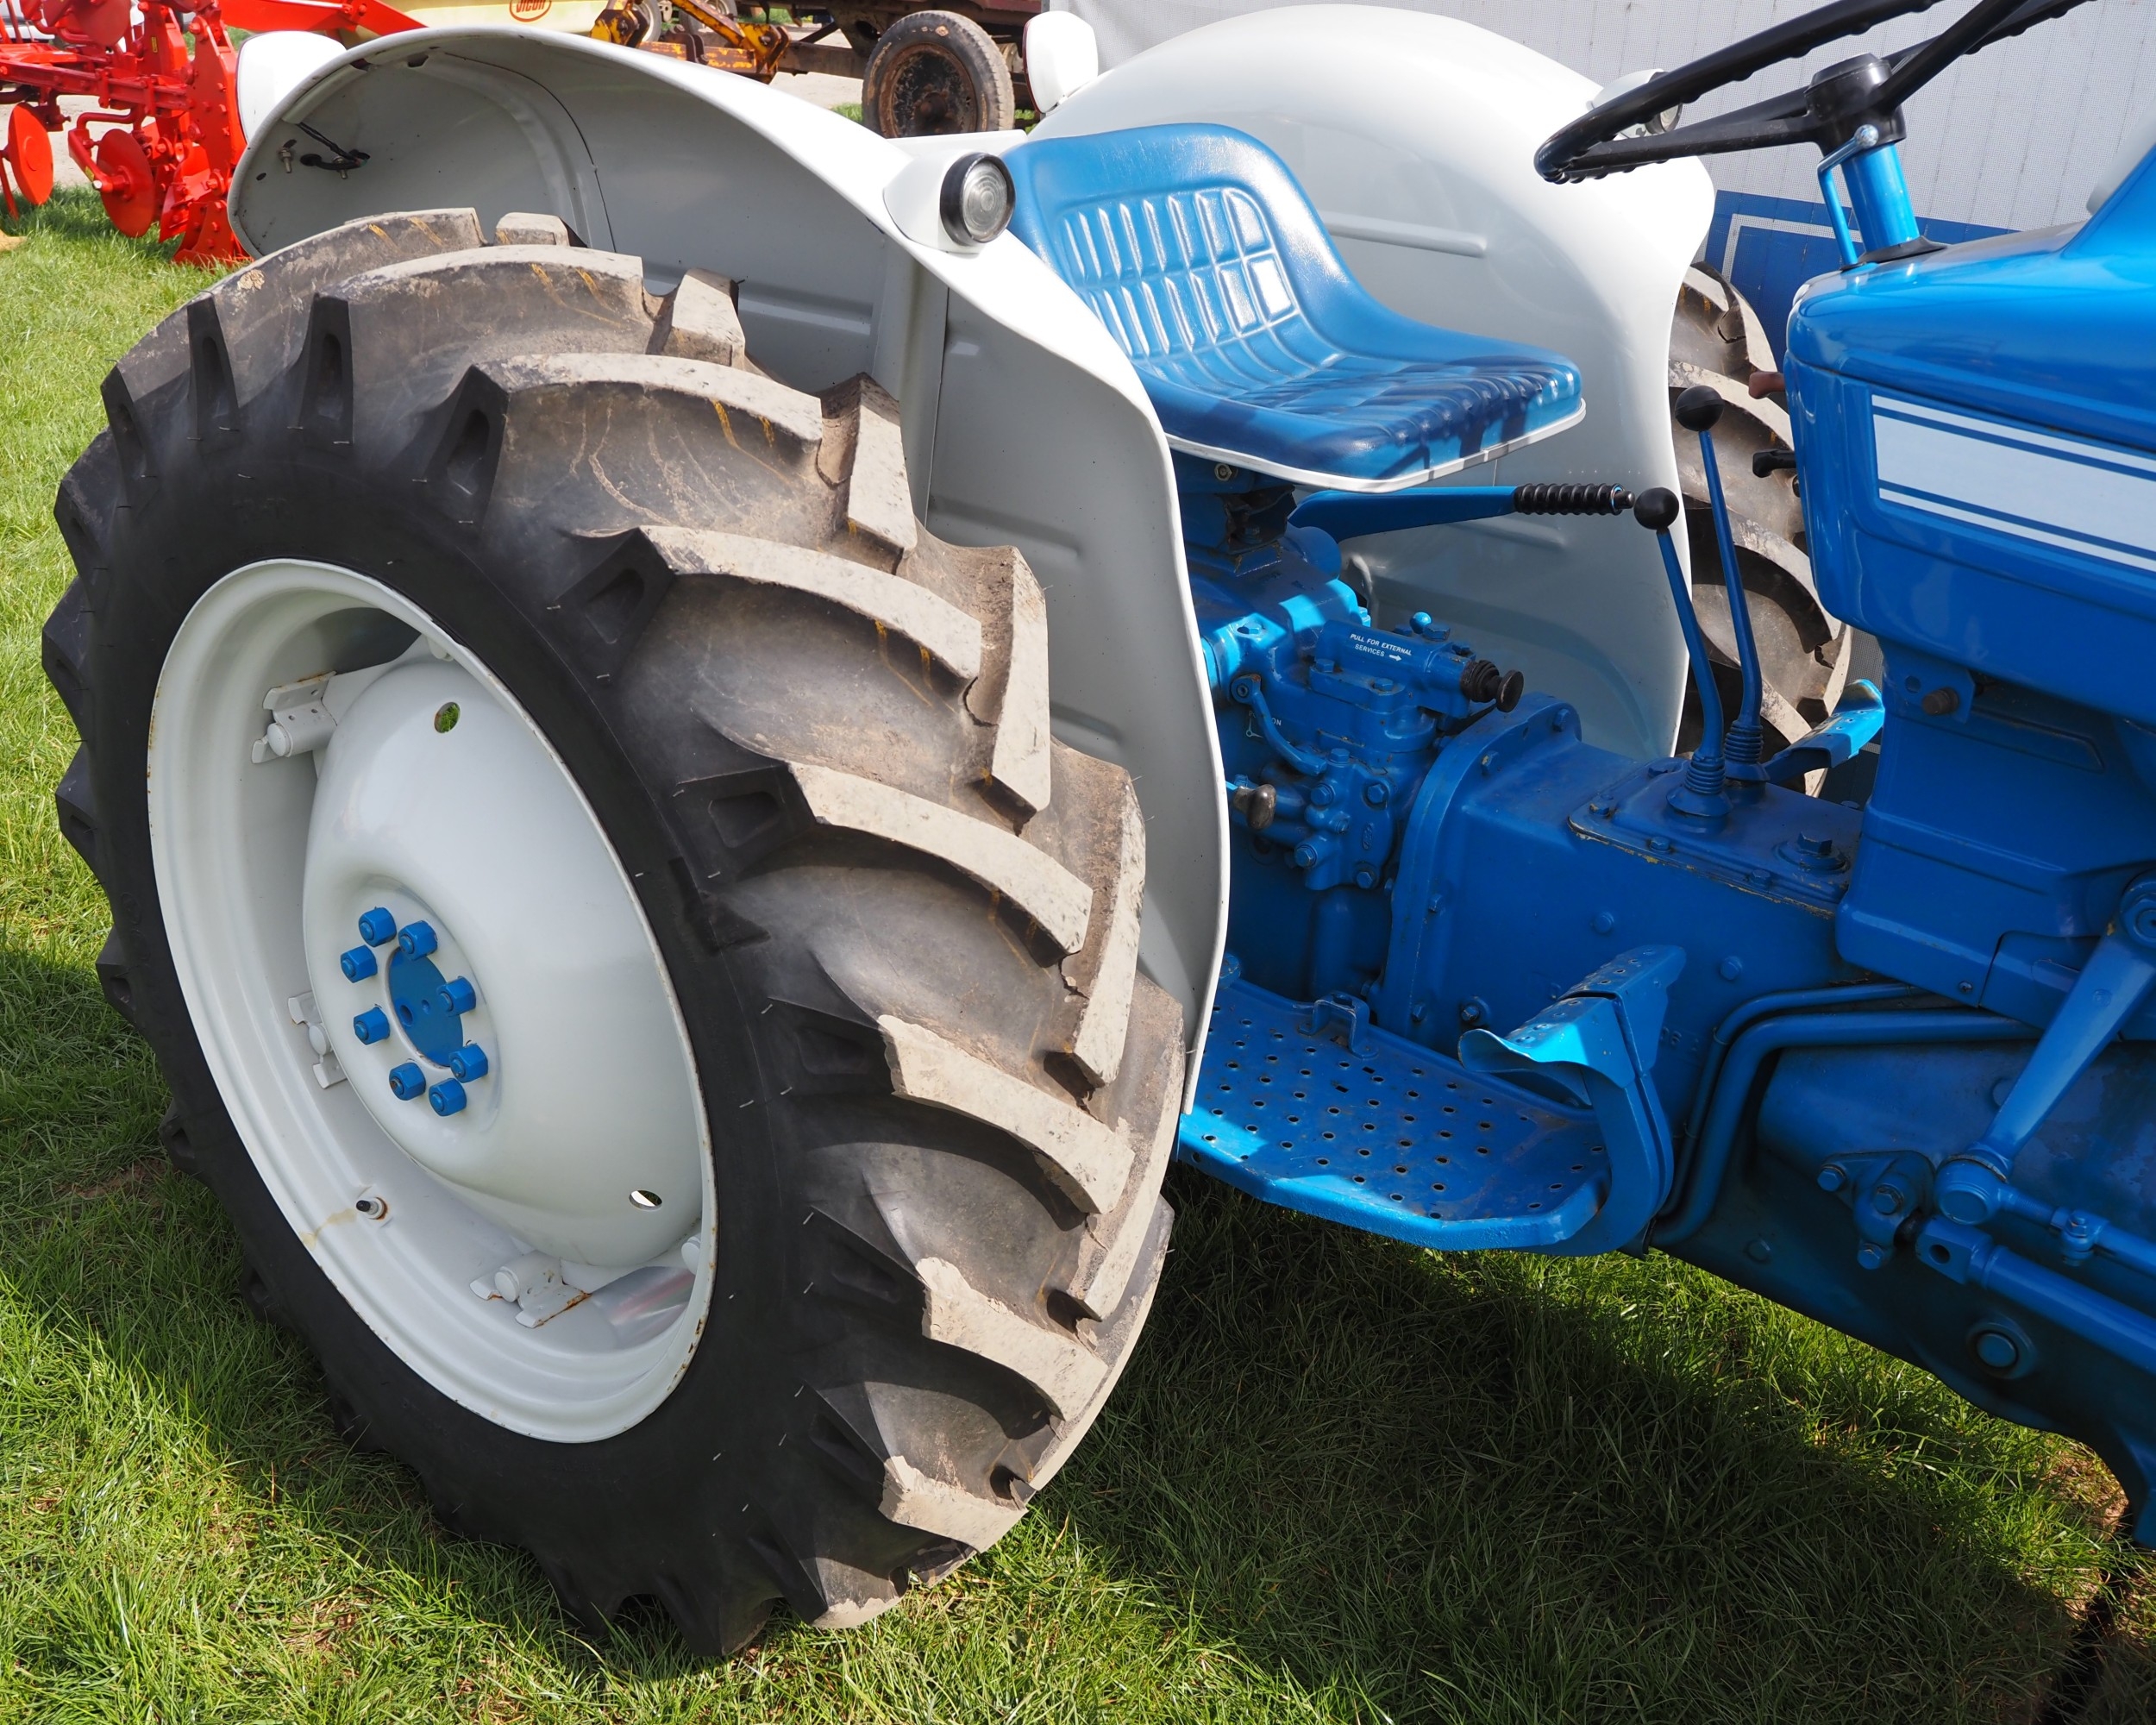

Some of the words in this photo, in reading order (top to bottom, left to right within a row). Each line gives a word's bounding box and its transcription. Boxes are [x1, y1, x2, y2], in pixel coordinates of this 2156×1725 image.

[1350, 633, 1364, 643] PULL
[1382, 643, 1412, 656] EXTERNAL
[1355, 643, 1385, 657] SERVICES
